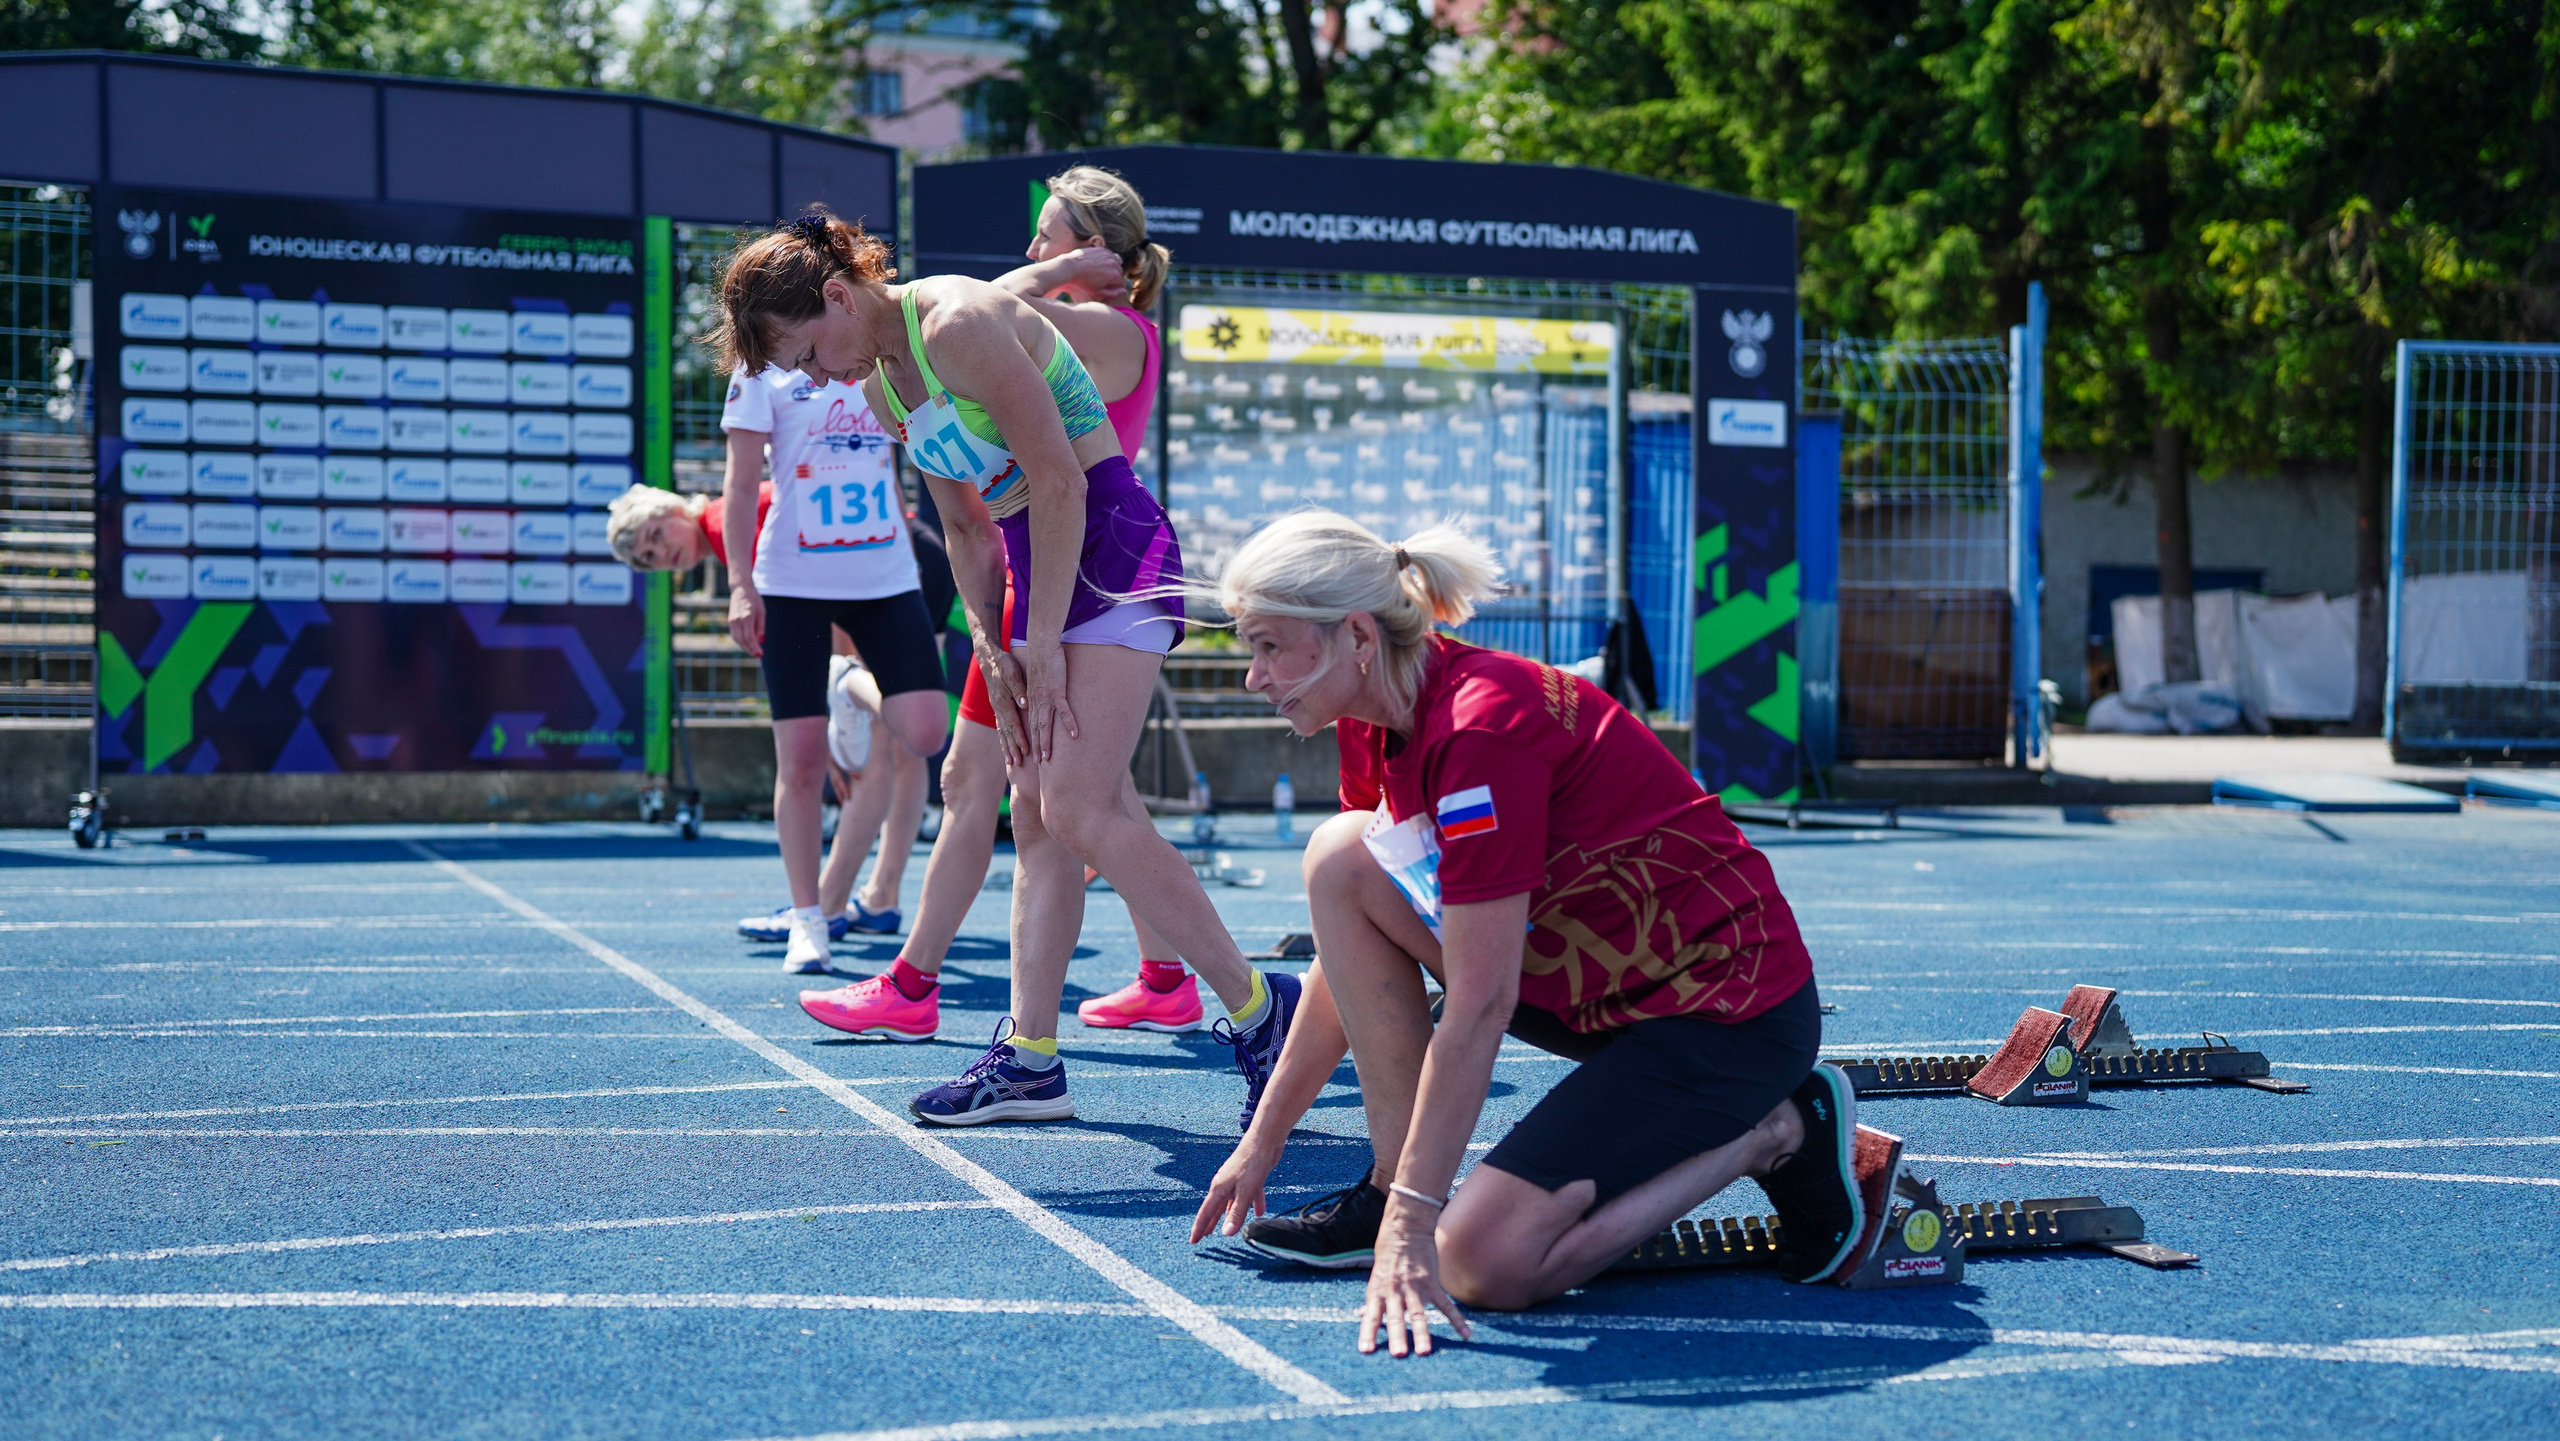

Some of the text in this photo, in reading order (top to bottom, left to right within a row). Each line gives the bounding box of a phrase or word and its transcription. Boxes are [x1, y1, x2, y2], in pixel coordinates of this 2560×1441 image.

[1230, 210, 1699, 254] МОЛОДЕЖНАЯ ФУТБОЛЬНАЯ ЛИГА
[250, 235, 634, 275] ЮНОШЕСКАЯ ФУТБОЛЬНАЯ ЛИГА
[1433, 334, 1482, 353] ЛИГА
[914, 421, 986, 480] 127
[809, 479, 888, 526] 131
[1888, 1260, 1942, 1271] POLANIK
